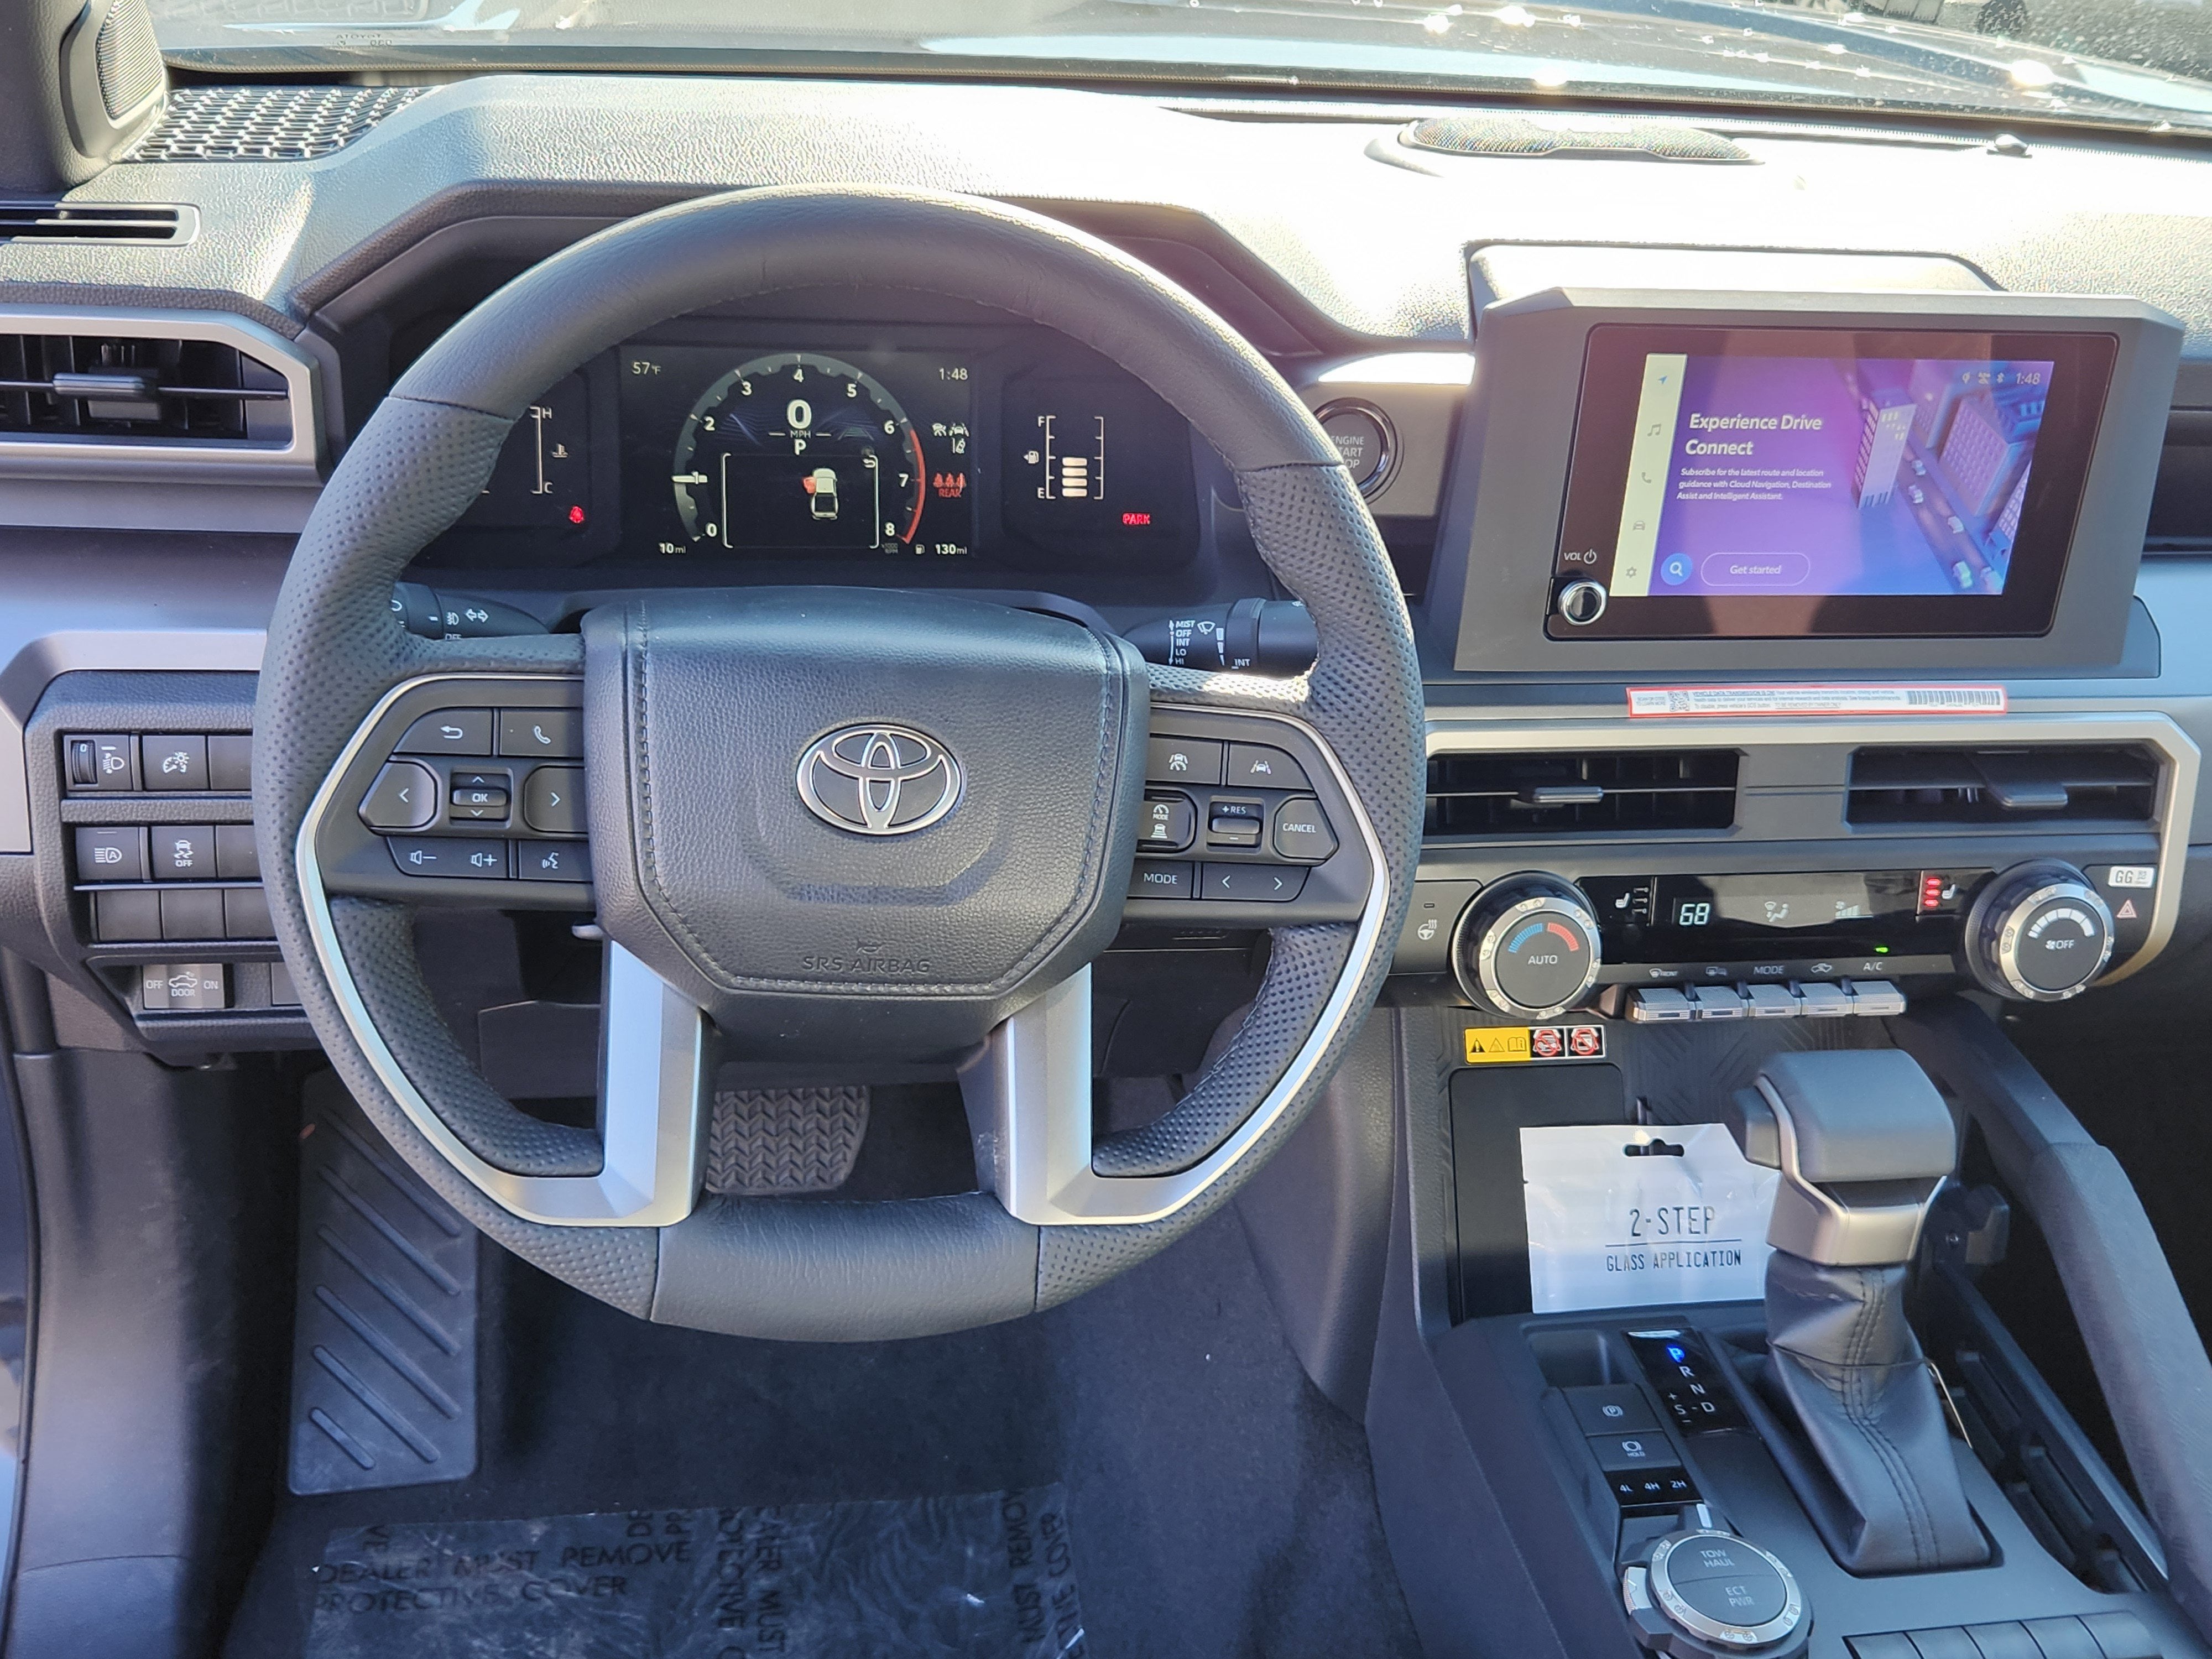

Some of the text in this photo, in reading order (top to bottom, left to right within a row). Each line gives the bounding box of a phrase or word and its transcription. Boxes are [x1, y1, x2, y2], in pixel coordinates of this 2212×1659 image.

[794, 369, 804, 383] 4
[938, 368, 969, 380] 1:48
[2016, 373, 2041, 384] 1:48
[742, 382, 753, 396] 3
[847, 384, 857, 398] 5
[542, 408, 552, 419] H
[786, 399, 812, 430] 0
[704, 417, 715, 431] 2
[884, 420, 895, 434] 6
[1038, 416, 1045, 427] F
[1689, 413, 1822, 432] Experience Drive
[1331, 436, 1365, 445] ENGINE
[794, 439, 806, 455] P
[1340, 447, 1363, 457] TART
[1686, 439, 1754, 455] Connect
[1681, 468, 1715, 476] Subscribe
[691, 472, 699, 484] 1
[898, 474, 909, 487] 7
[544, 482, 553, 493] C
[1678, 481, 1712, 489] guidance
[1752, 481, 1791, 489] Navigation,
[938, 488, 961, 497] REAR
[1037, 487, 1045, 498] E
[1123, 513, 1151, 525] PARK
[707, 523, 717, 537] 0
[885, 522, 895, 536] 8
[1730, 565, 1781, 575] Get started
[1176, 620, 1196, 628] MIST
[1176, 638, 1190, 646] INT
[1234, 658, 1250, 667] INT
[472, 794, 488, 802] OK
[1282, 823, 1316, 833] CANCEL
[1144, 873, 1178, 885] MODE
[2115, 870, 2133, 884] GG
[1679, 902, 1710, 926] 68
[2055, 940, 2074, 949] OFF
[803, 956, 932, 974] SRS AIRBAG
[1528, 955, 1558, 964] AUTO
[1753, 966, 1784, 974] MODE
[1863, 962, 1883, 971] A/C
[146, 980, 163, 989] OFF
[203, 980, 218, 989] ON
[1629, 1206, 1715, 1237] 2-STEP
[1606, 1250, 1741, 1271] GLASS APPLICATION
[1668, 1346, 1685, 1363] P
[1679, 1366, 1694, 1378] R
[1691, 1384, 1705, 1395] N
[1674, 1404, 1686, 1415] S
[1701, 1402, 1715, 1412] D
[1620, 1484, 1633, 1492] 4L
[1644, 1482, 1660, 1490] 4H
[1670, 1480, 1687, 1489] 2H
[561, 1540, 691, 1568] REMOVE
[1700, 1550, 1728, 1558] TOW
[1703, 1558, 1735, 1567] HAUL
[521, 1575, 629, 1602] COVER
[1725, 1585, 1746, 1595] ECT
[1729, 1596, 1755, 1607] PWR
